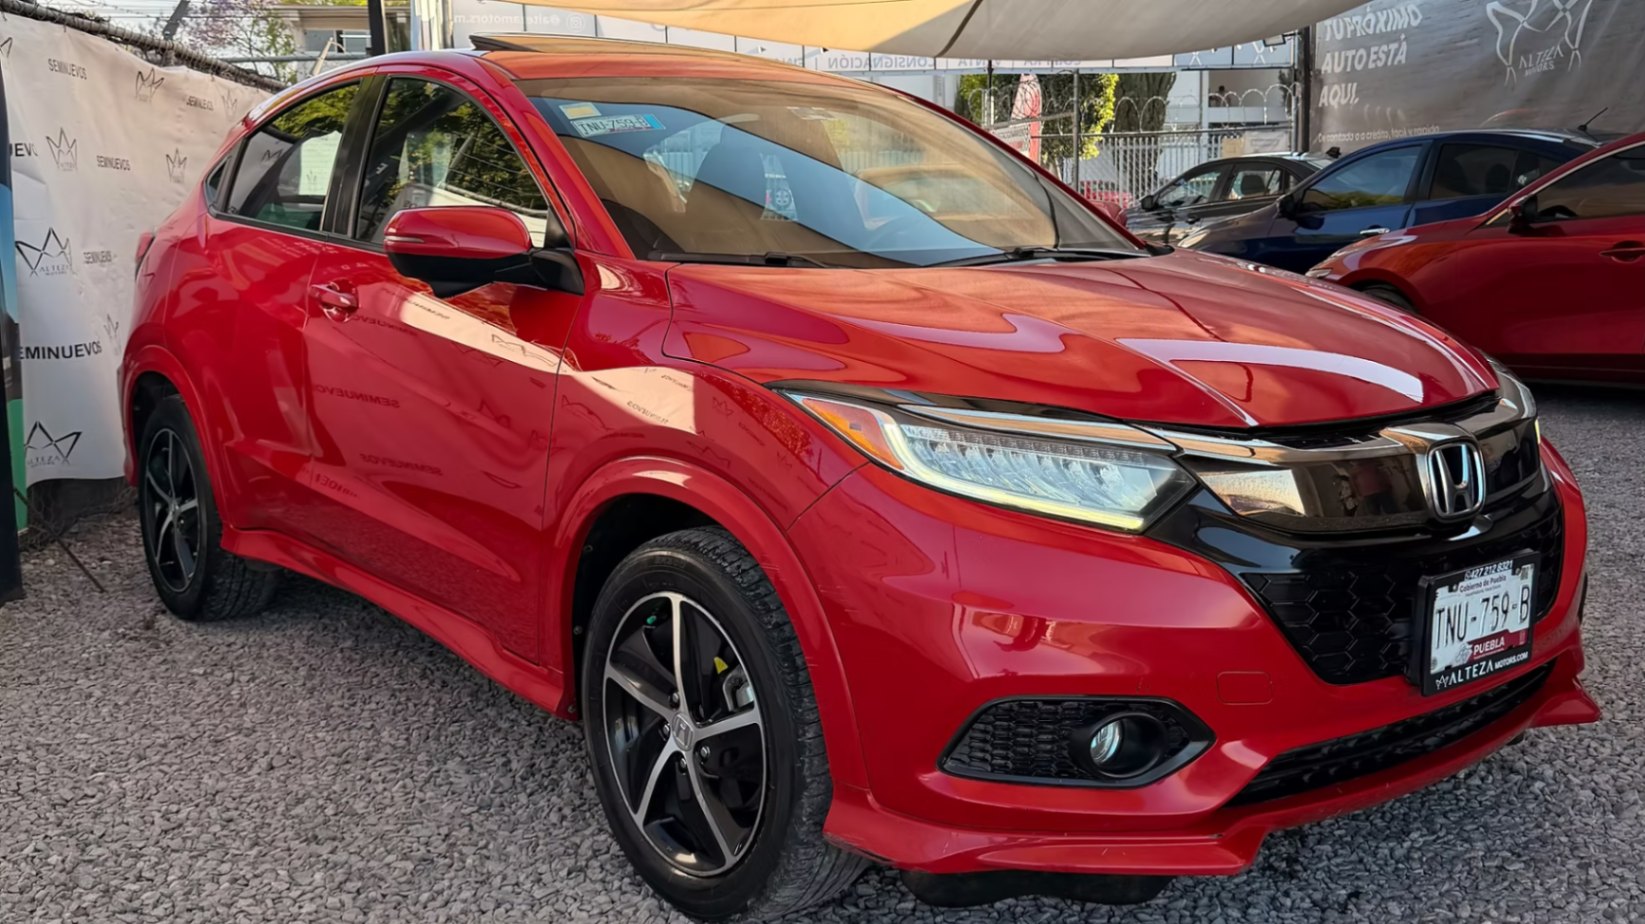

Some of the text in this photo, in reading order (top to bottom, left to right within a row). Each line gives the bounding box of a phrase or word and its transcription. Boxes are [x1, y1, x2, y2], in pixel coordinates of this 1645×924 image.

[1324, 4, 1423, 41] TU PRÓXIMO
[1321, 33, 1408, 75] AUTO ESTÁ
[1435, 585, 1530, 650] TNU-759-B
[1472, 636, 1506, 656] PUEBLA
[1448, 660, 1494, 686] ALTEZA
